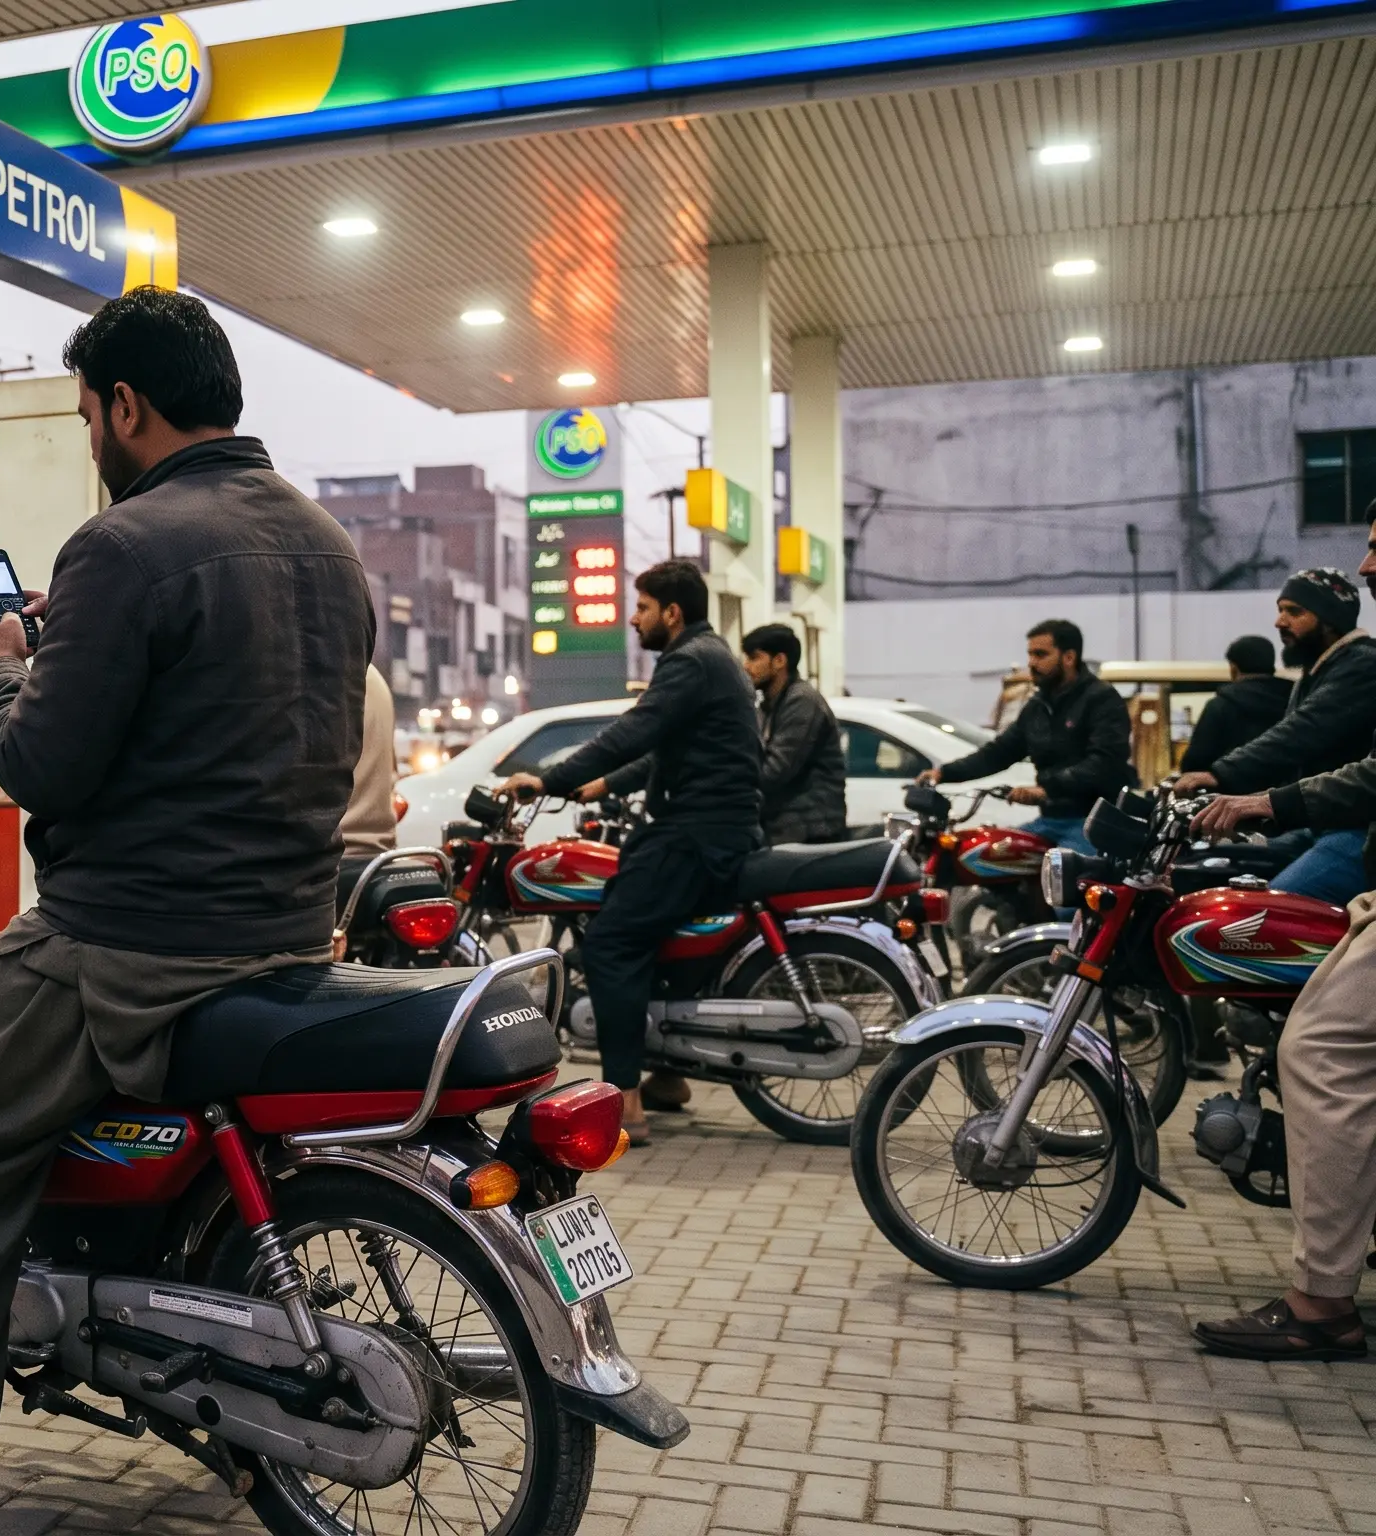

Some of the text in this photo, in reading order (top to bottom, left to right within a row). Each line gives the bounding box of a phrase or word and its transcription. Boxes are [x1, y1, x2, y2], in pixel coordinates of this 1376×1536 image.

[105, 41, 190, 95] PSO
[550, 424, 601, 455] PSO
[481, 1006, 543, 1033] HONDA
